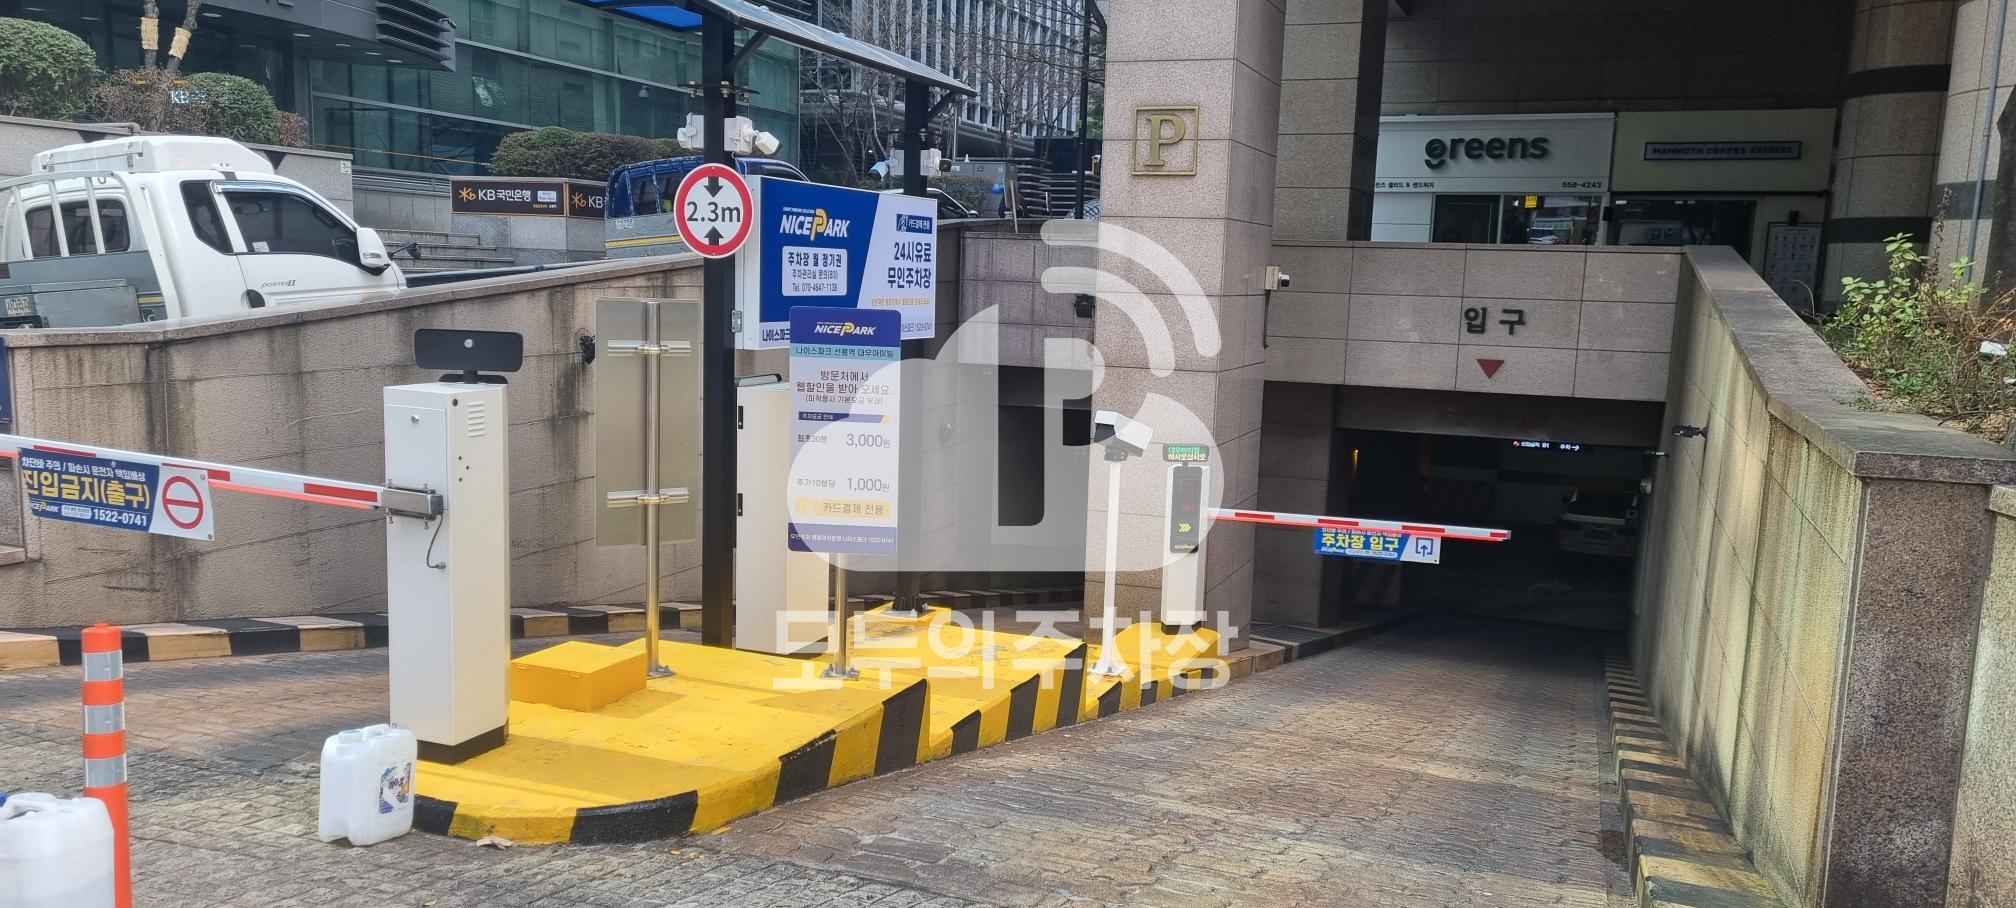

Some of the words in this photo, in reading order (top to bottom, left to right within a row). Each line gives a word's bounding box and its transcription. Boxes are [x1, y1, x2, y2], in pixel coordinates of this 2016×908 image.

[1144, 114, 1185, 166] P
[1424, 136, 1551, 170] greens
[478, 190, 532, 202] KB국민은행
[686, 201, 740, 222] 2.3m
[780, 208, 850, 241] NICEPARK
[788, 252, 809, 266] 주차장
[813, 253, 819, 267] 월
[822, 254, 842, 268] 정기권
[894, 242, 932, 262] 24시유료
[888, 267, 931, 289] 무인주차장
[814, 322, 876, 336] NICEPARK
[1464, 307, 1526, 335] 입구
[796, 346, 832, 356] 나이스파크
[834, 348, 856, 357] 선릉역
[858, 349, 894, 358] 대우아이빌
[820, 370, 869, 382] 방문처에서
[796, 382, 835, 394] 웹할인을
[838, 384, 857, 394] 받아
[797, 434, 828, 444] 최초30분
[846, 434, 890, 448] 3,000원
[46, 460, 61, 471] 주의
[68, 462, 90, 475] 파손시
[92, 466, 114, 478] 운전자
[115, 469, 146, 481] 책임배상
[23, 470, 150, 509] 진입금지(출구)
[796, 479, 836, 488] 추가10분당
[848, 478, 890, 492] 1,000원
[32, 502, 60, 512] CEPARK
[93, 508, 147, 526] 1522-0741
[823, 502, 861, 514] 카드결제
[865, 504, 884, 515] 전용
[1322, 533, 1365, 549] 주차장
[1370, 537, 1399, 552] 입구
